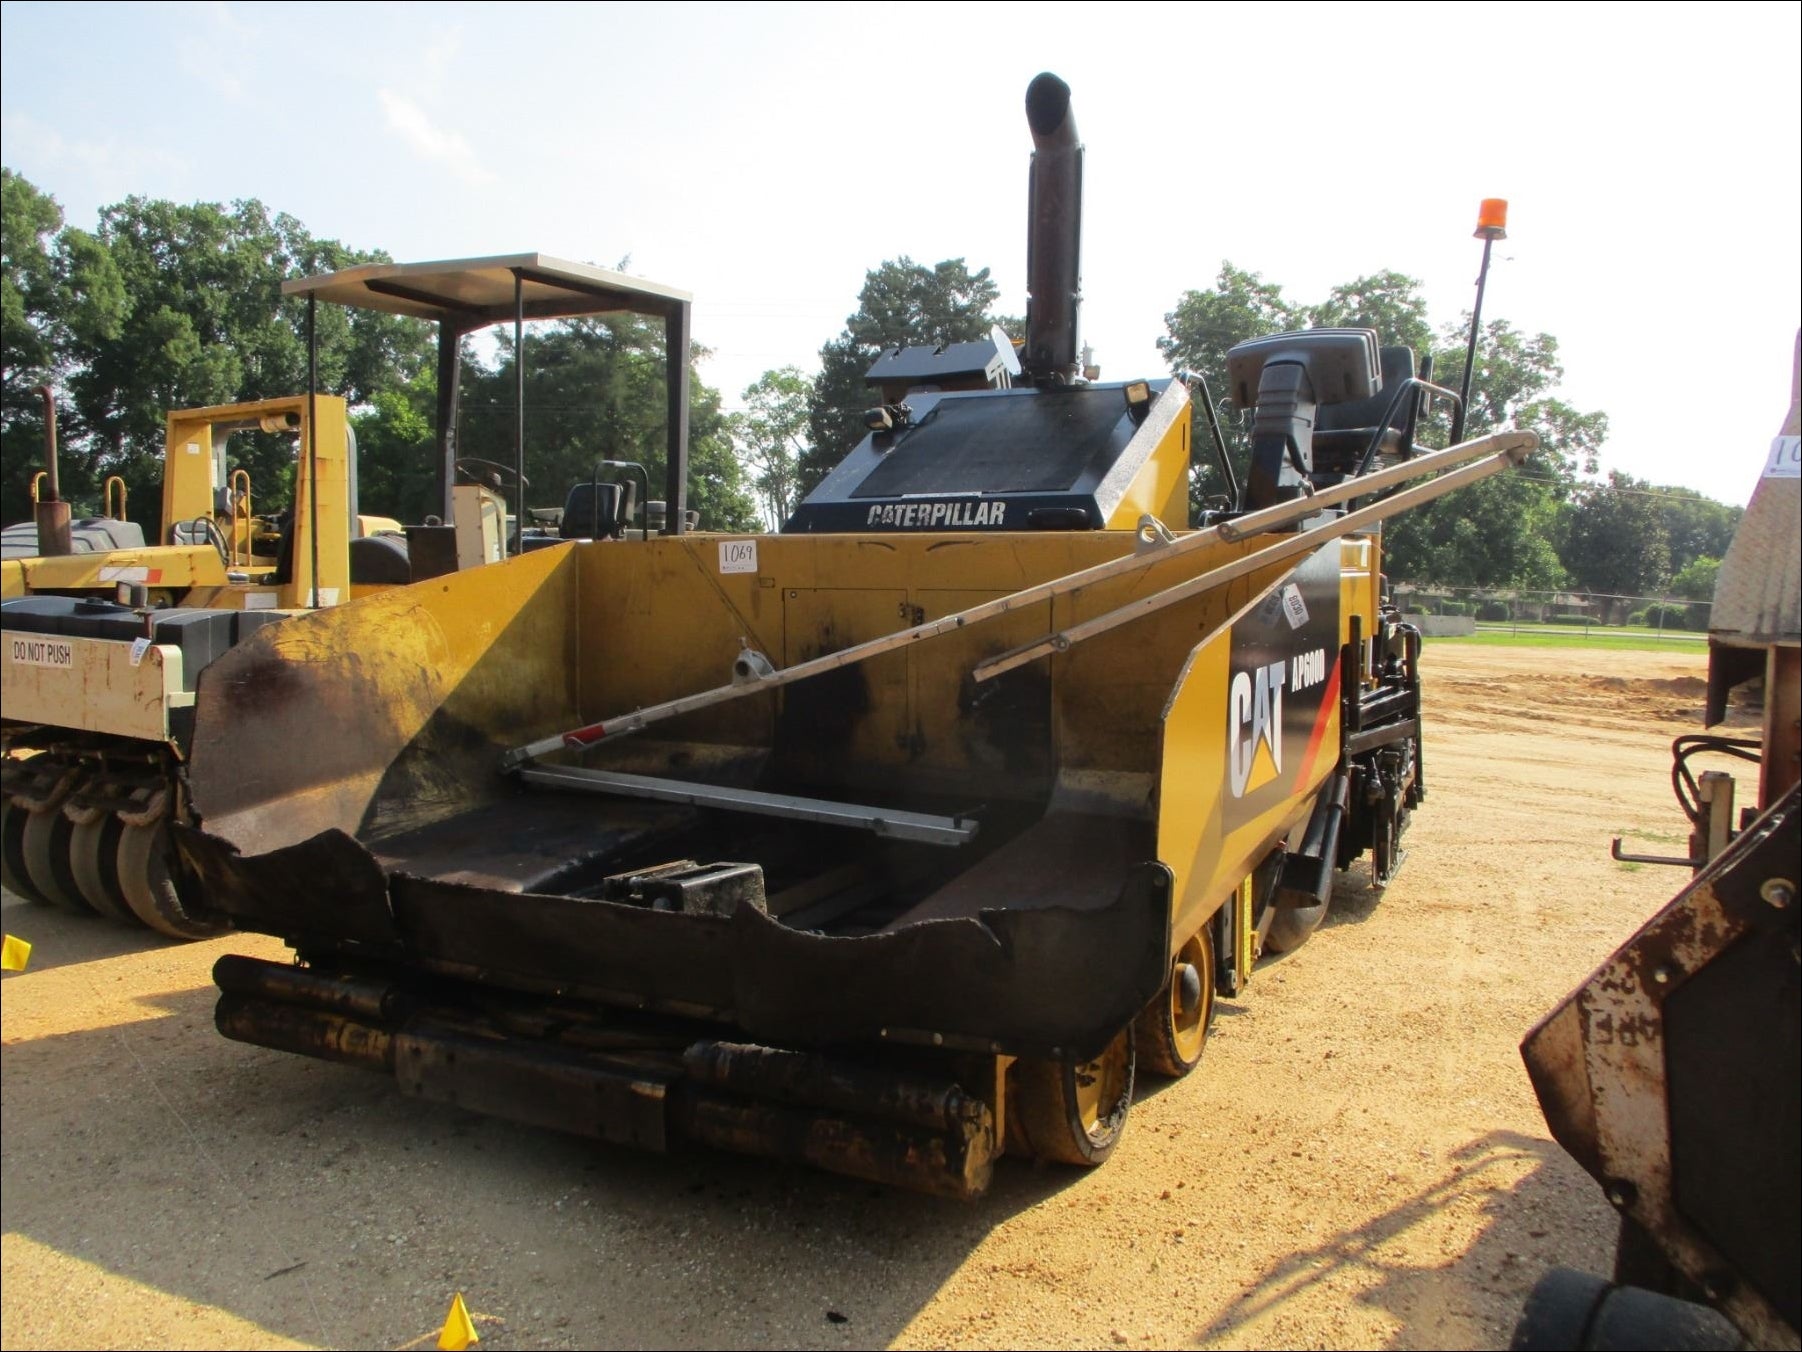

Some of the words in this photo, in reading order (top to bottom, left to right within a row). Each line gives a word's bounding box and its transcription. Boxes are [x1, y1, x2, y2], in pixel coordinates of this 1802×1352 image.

[867, 501, 1006, 527] CATERPILLAR
[724, 544, 753, 563] 1069
[14, 641, 26, 660] DO
[28, 643, 45, 662] NOT
[47, 643, 71, 665] PUSH
[1230, 660, 1286, 798] CAT
